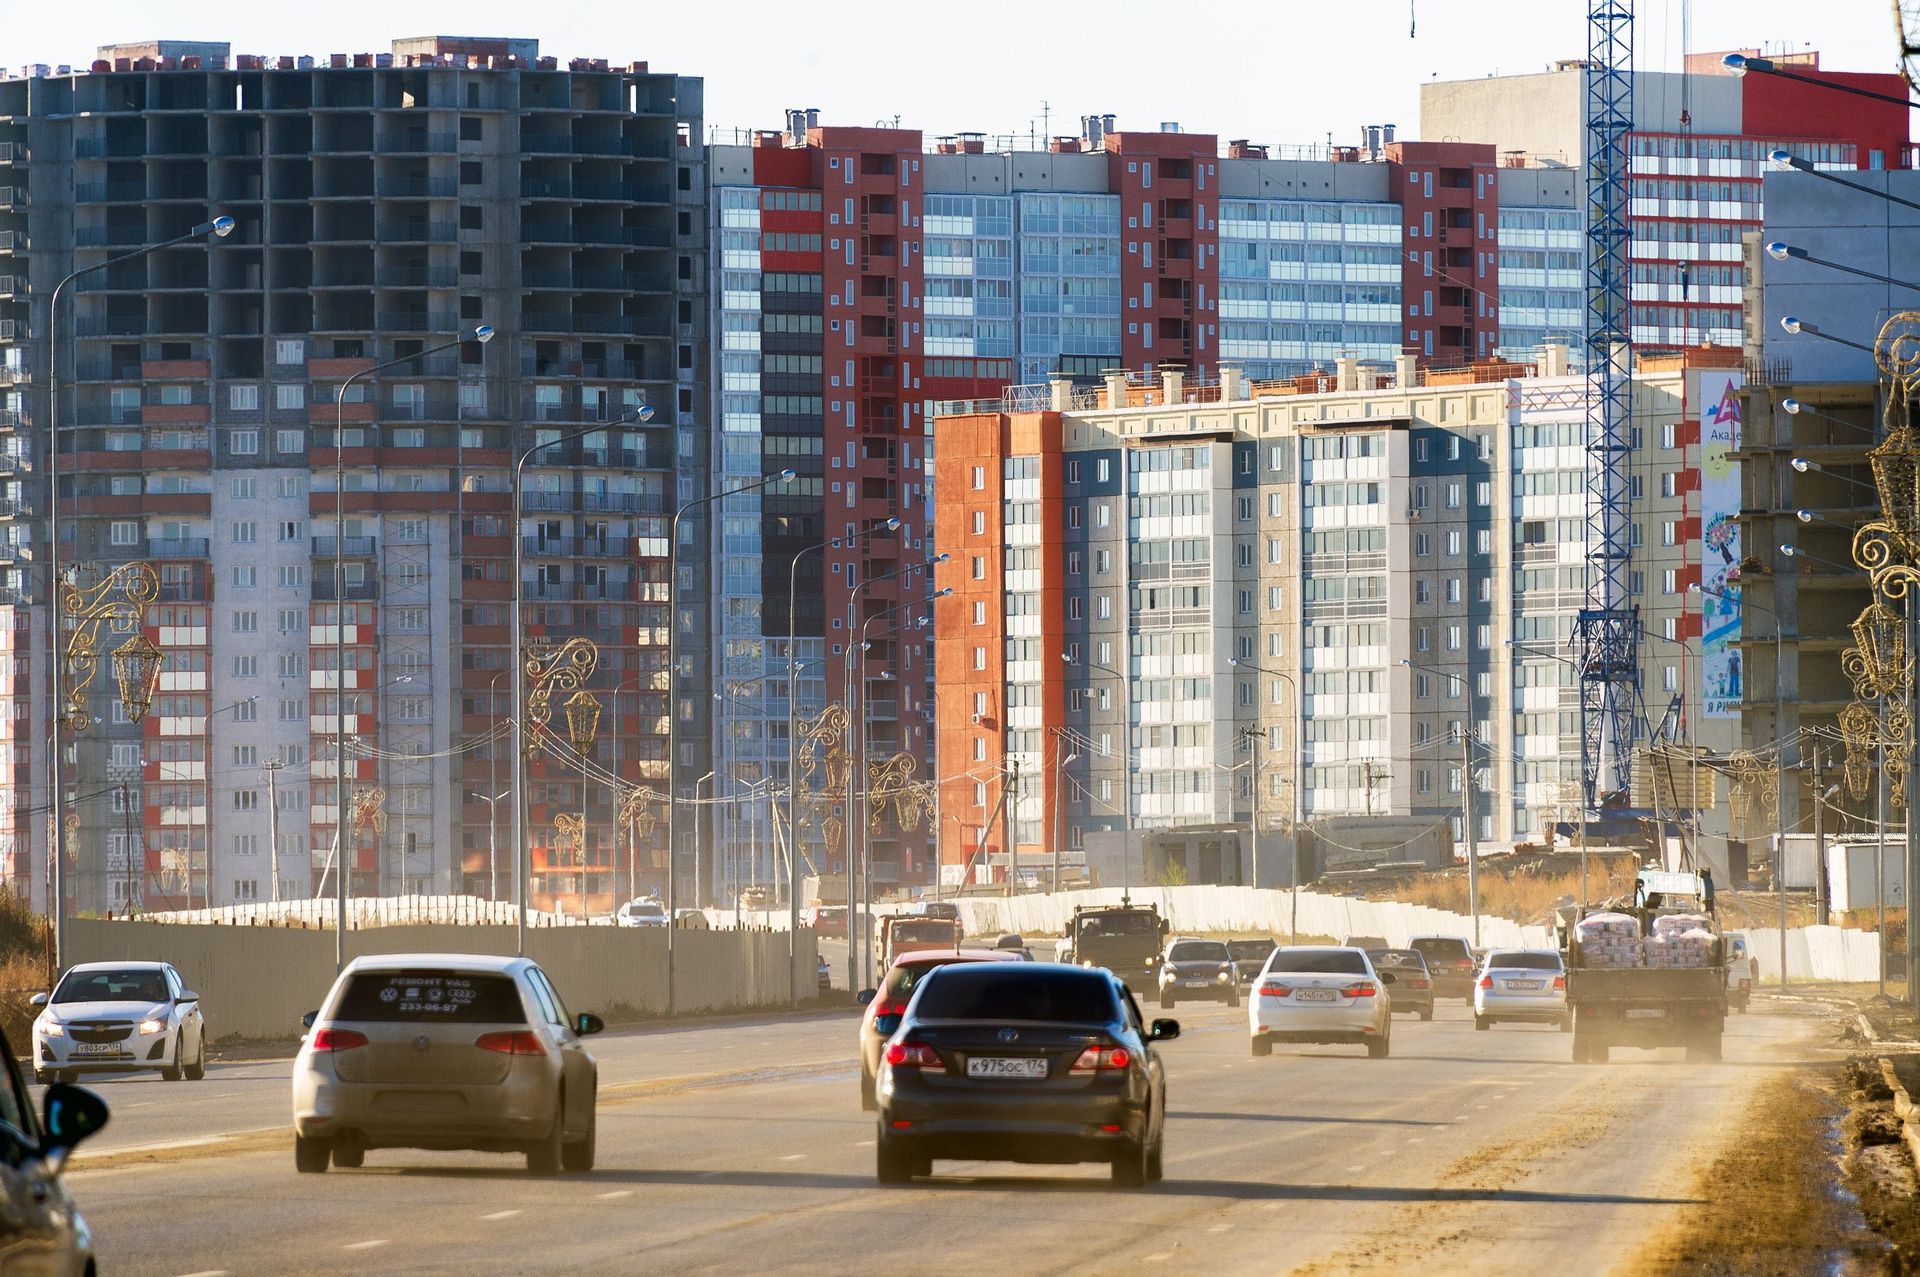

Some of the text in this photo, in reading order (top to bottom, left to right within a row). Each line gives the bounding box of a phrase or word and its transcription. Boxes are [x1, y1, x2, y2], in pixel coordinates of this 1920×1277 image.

[1708, 702, 1714, 713] Я
[446, 979, 470, 987] VAG
[400, 1002, 458, 1012] 233-06-97
